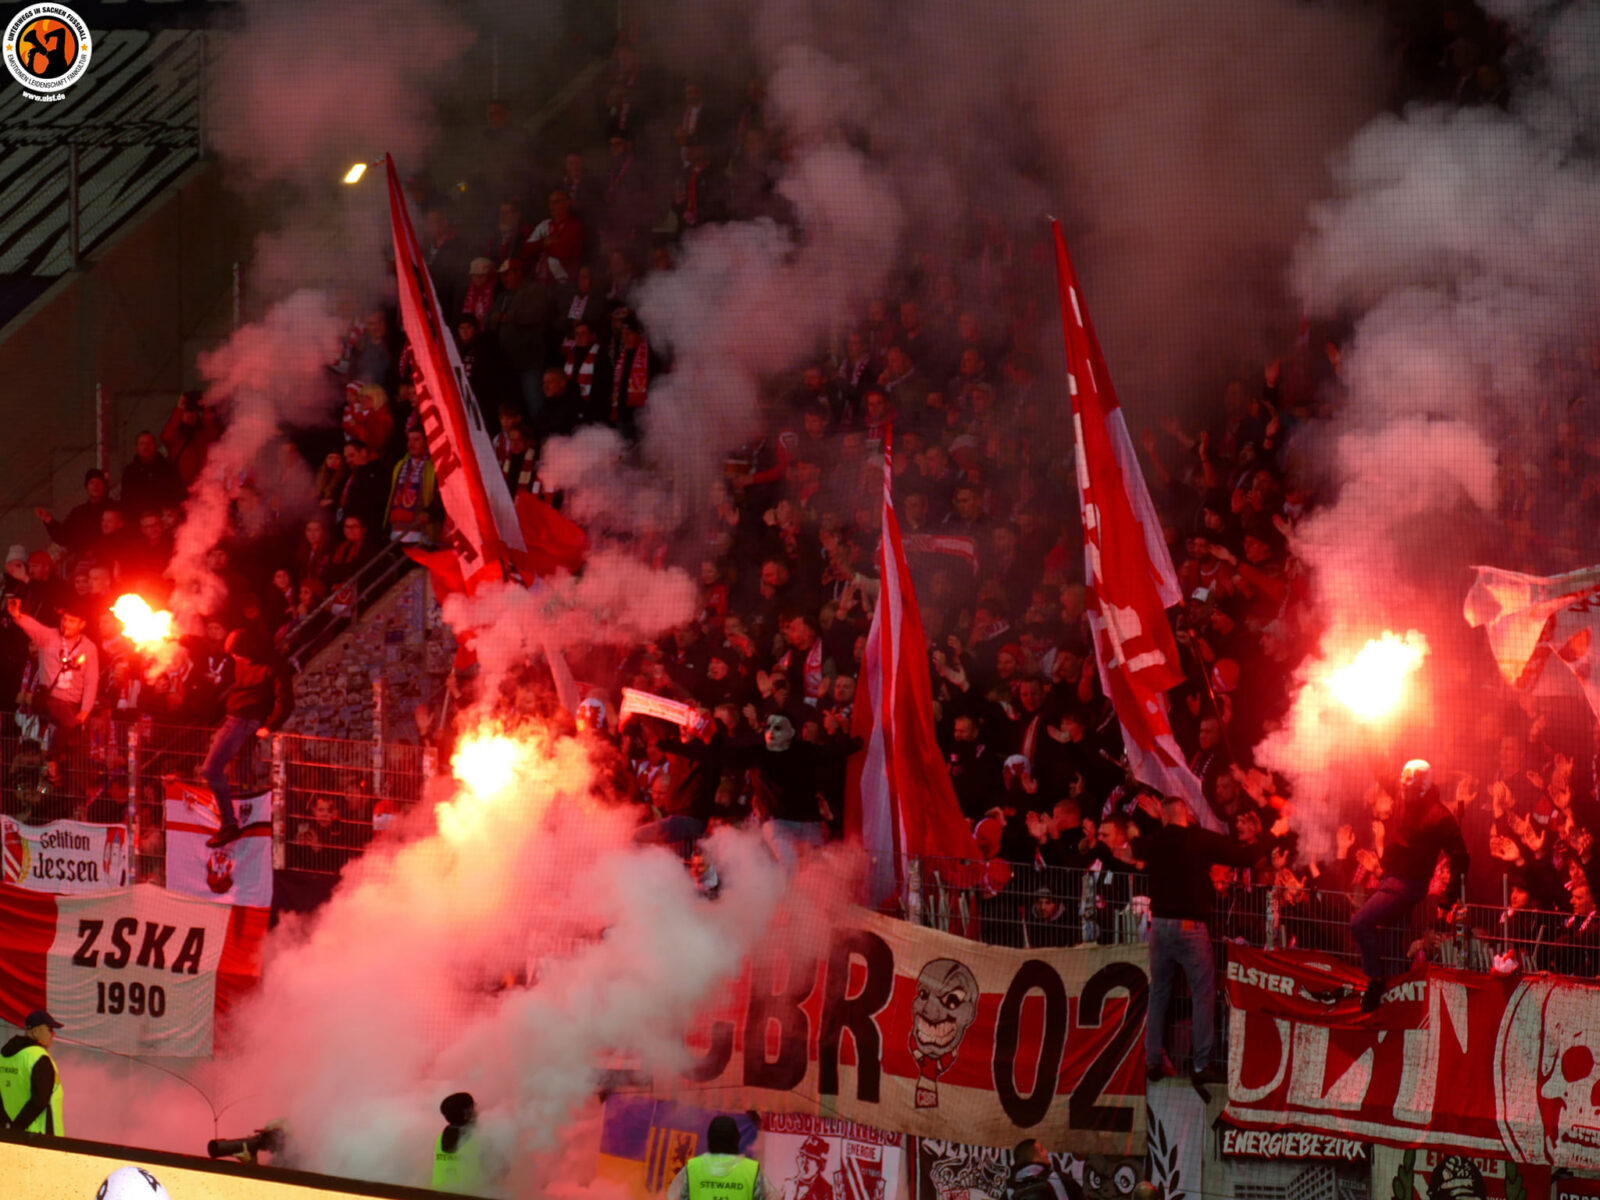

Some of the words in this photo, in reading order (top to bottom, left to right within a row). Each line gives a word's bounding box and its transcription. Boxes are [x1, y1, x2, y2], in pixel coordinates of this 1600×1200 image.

[33, 853, 99, 883] Jessen
[73, 917, 206, 975] ZSKA
[1227, 961, 1295, 997] ELSTER
[97, 982, 166, 1018] 1990
[992, 960, 1149, 1131] 02
[700, 1180, 744, 1190] STEWARD
